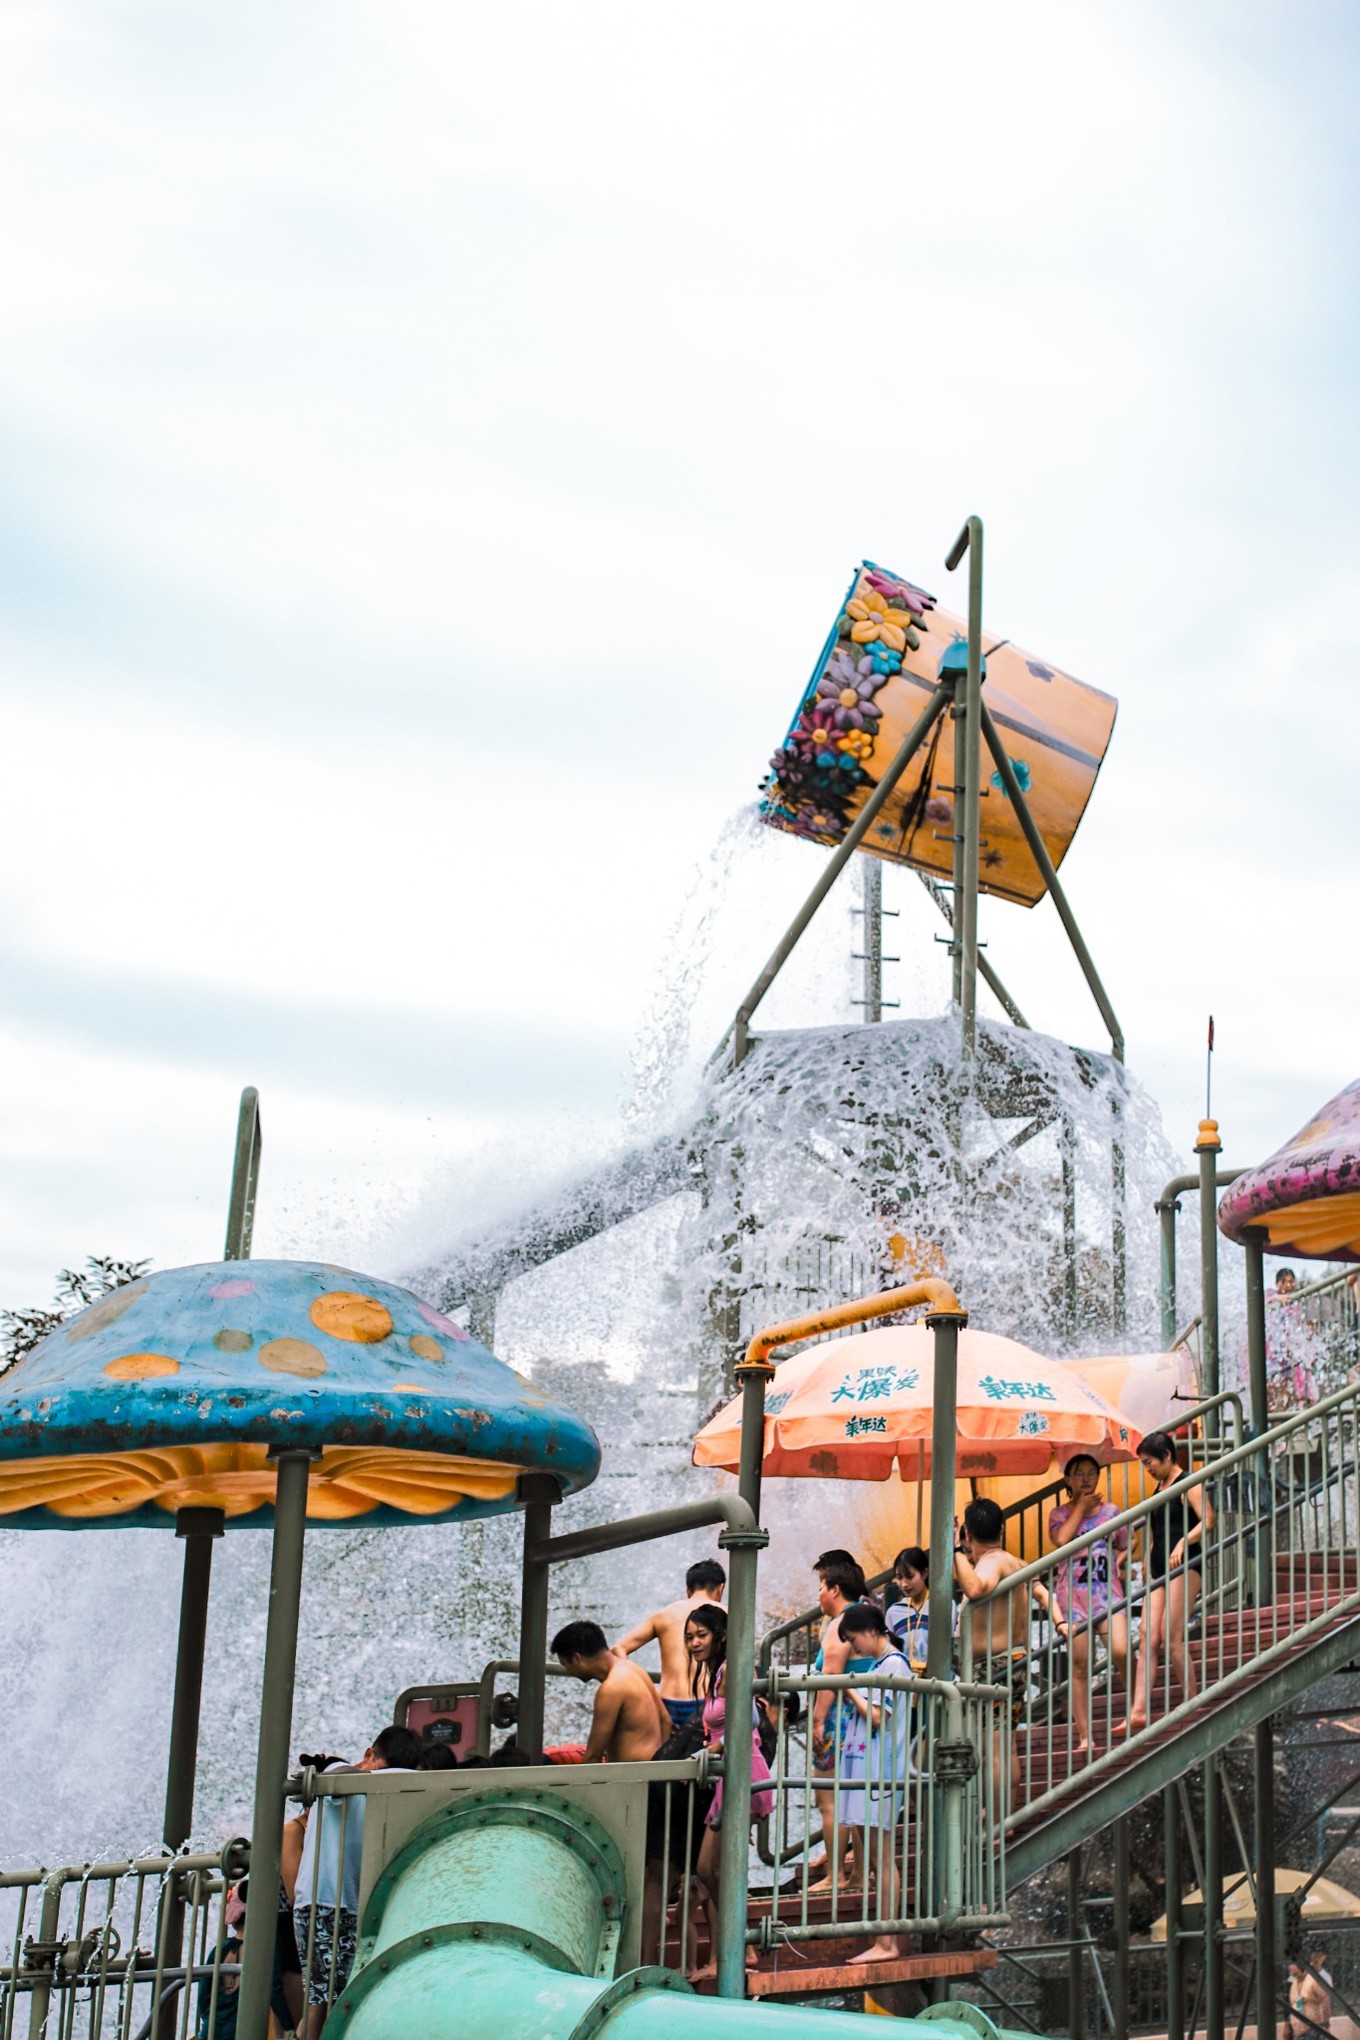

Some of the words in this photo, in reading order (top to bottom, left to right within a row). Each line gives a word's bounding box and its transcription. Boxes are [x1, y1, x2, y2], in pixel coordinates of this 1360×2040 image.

[830, 1369, 920, 1403] 大爆发
[856, 1365, 897, 1382] 果味
[978, 1375, 1057, 1401] 美年达
[845, 1415, 887, 1438] 美年达
[1077, 1555, 1108, 1583] 23
